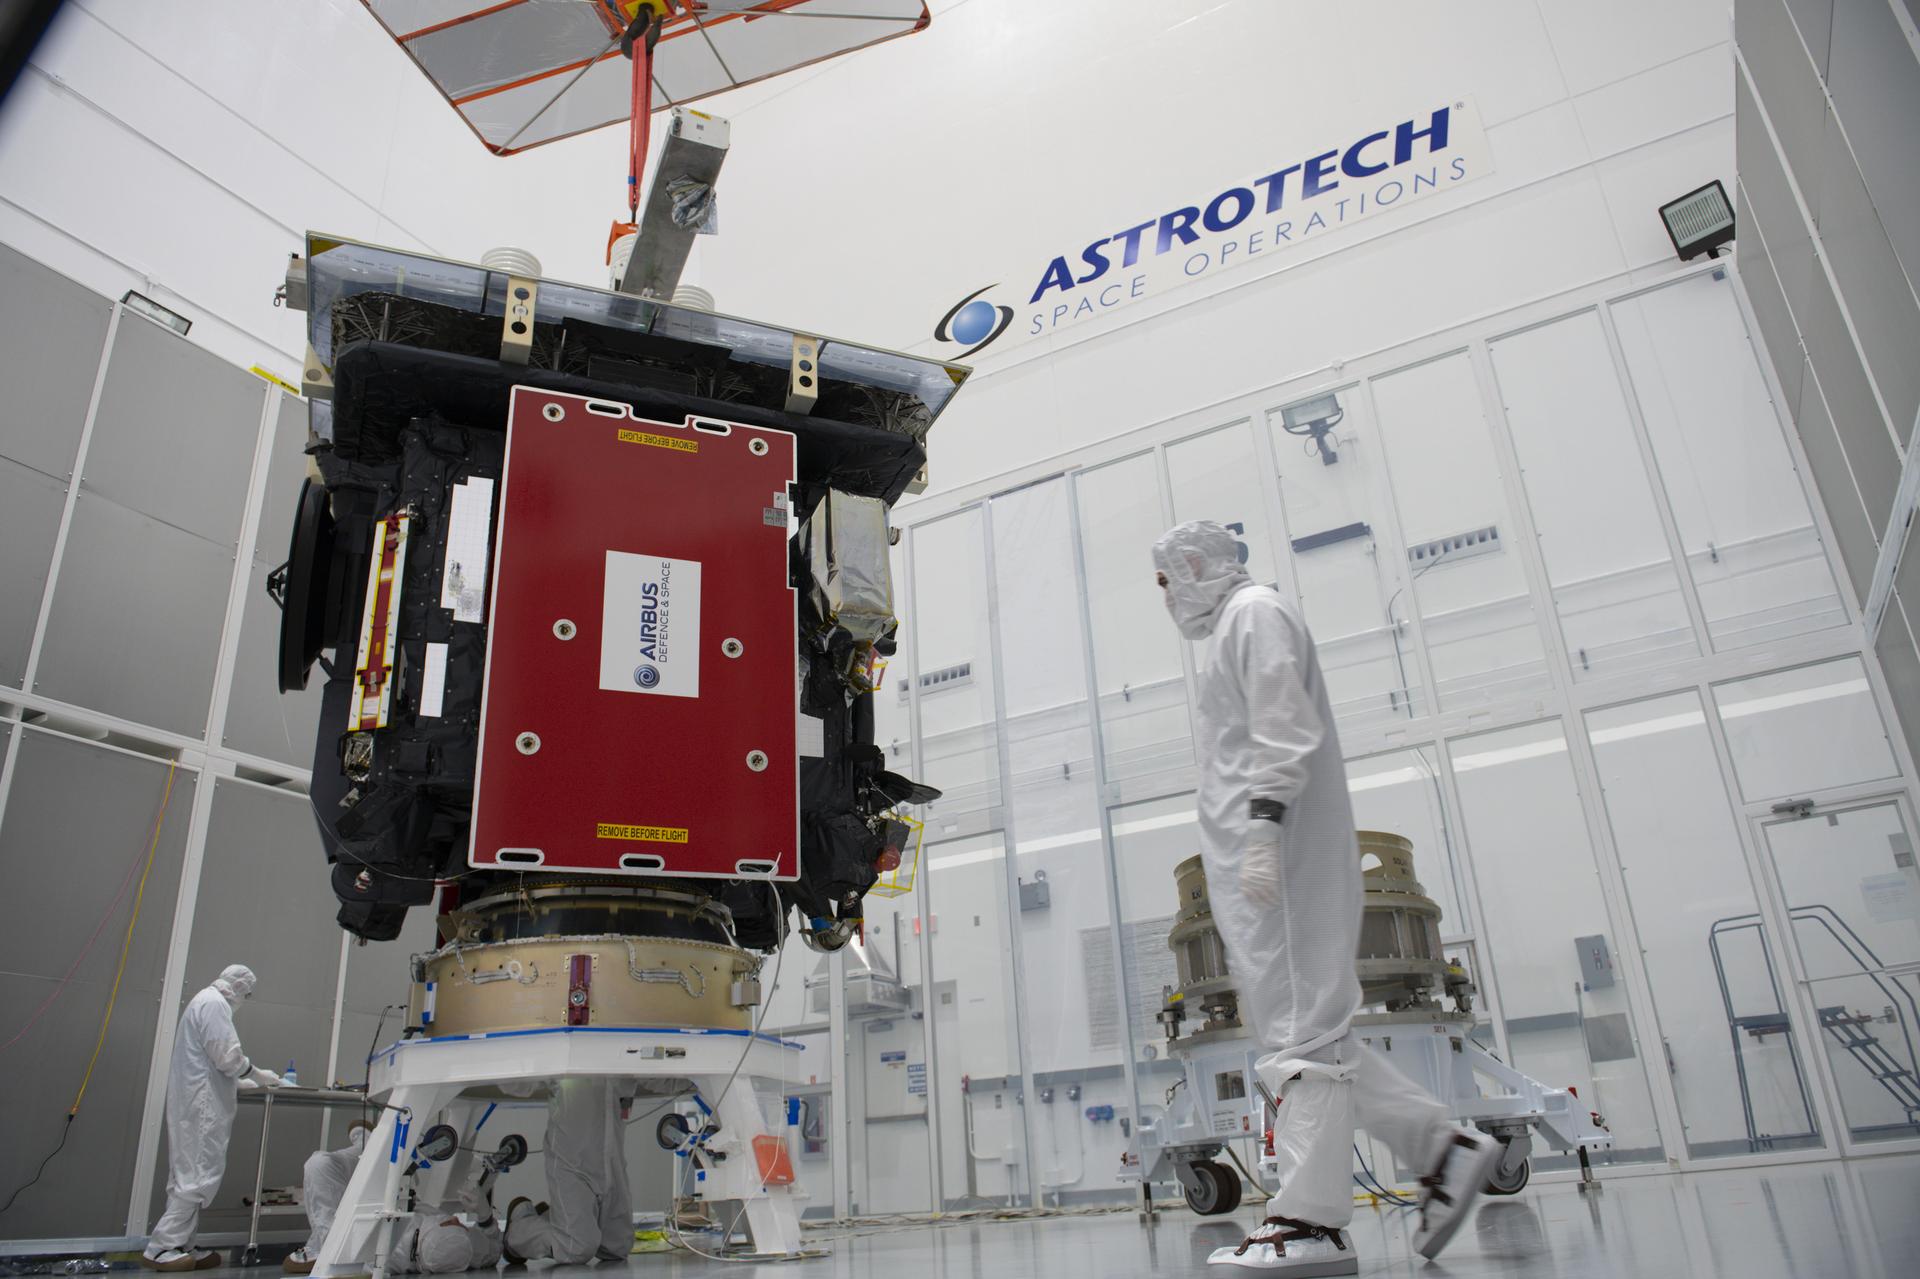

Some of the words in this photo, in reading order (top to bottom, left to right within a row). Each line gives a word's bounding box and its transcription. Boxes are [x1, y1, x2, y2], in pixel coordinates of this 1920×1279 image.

[1029, 107, 1449, 304] ASTROTECH
[1030, 274, 1147, 335] SPACE
[1184, 157, 1465, 276] OPERATIONS
[620, 430, 642, 441] FLIGHT
[644, 434, 670, 446] BEFORE
[671, 439, 697, 451] REMOVE
[661, 562, 671, 597] SPACE
[660, 600, 669, 608] &
[640, 582, 658, 661] AIRBUS
[659, 608, 669, 663] DEFENCE
[598, 825, 629, 837] REMOVE
[630, 827, 660, 840] BEFORE
[661, 829, 687, 841] FLIGHT
